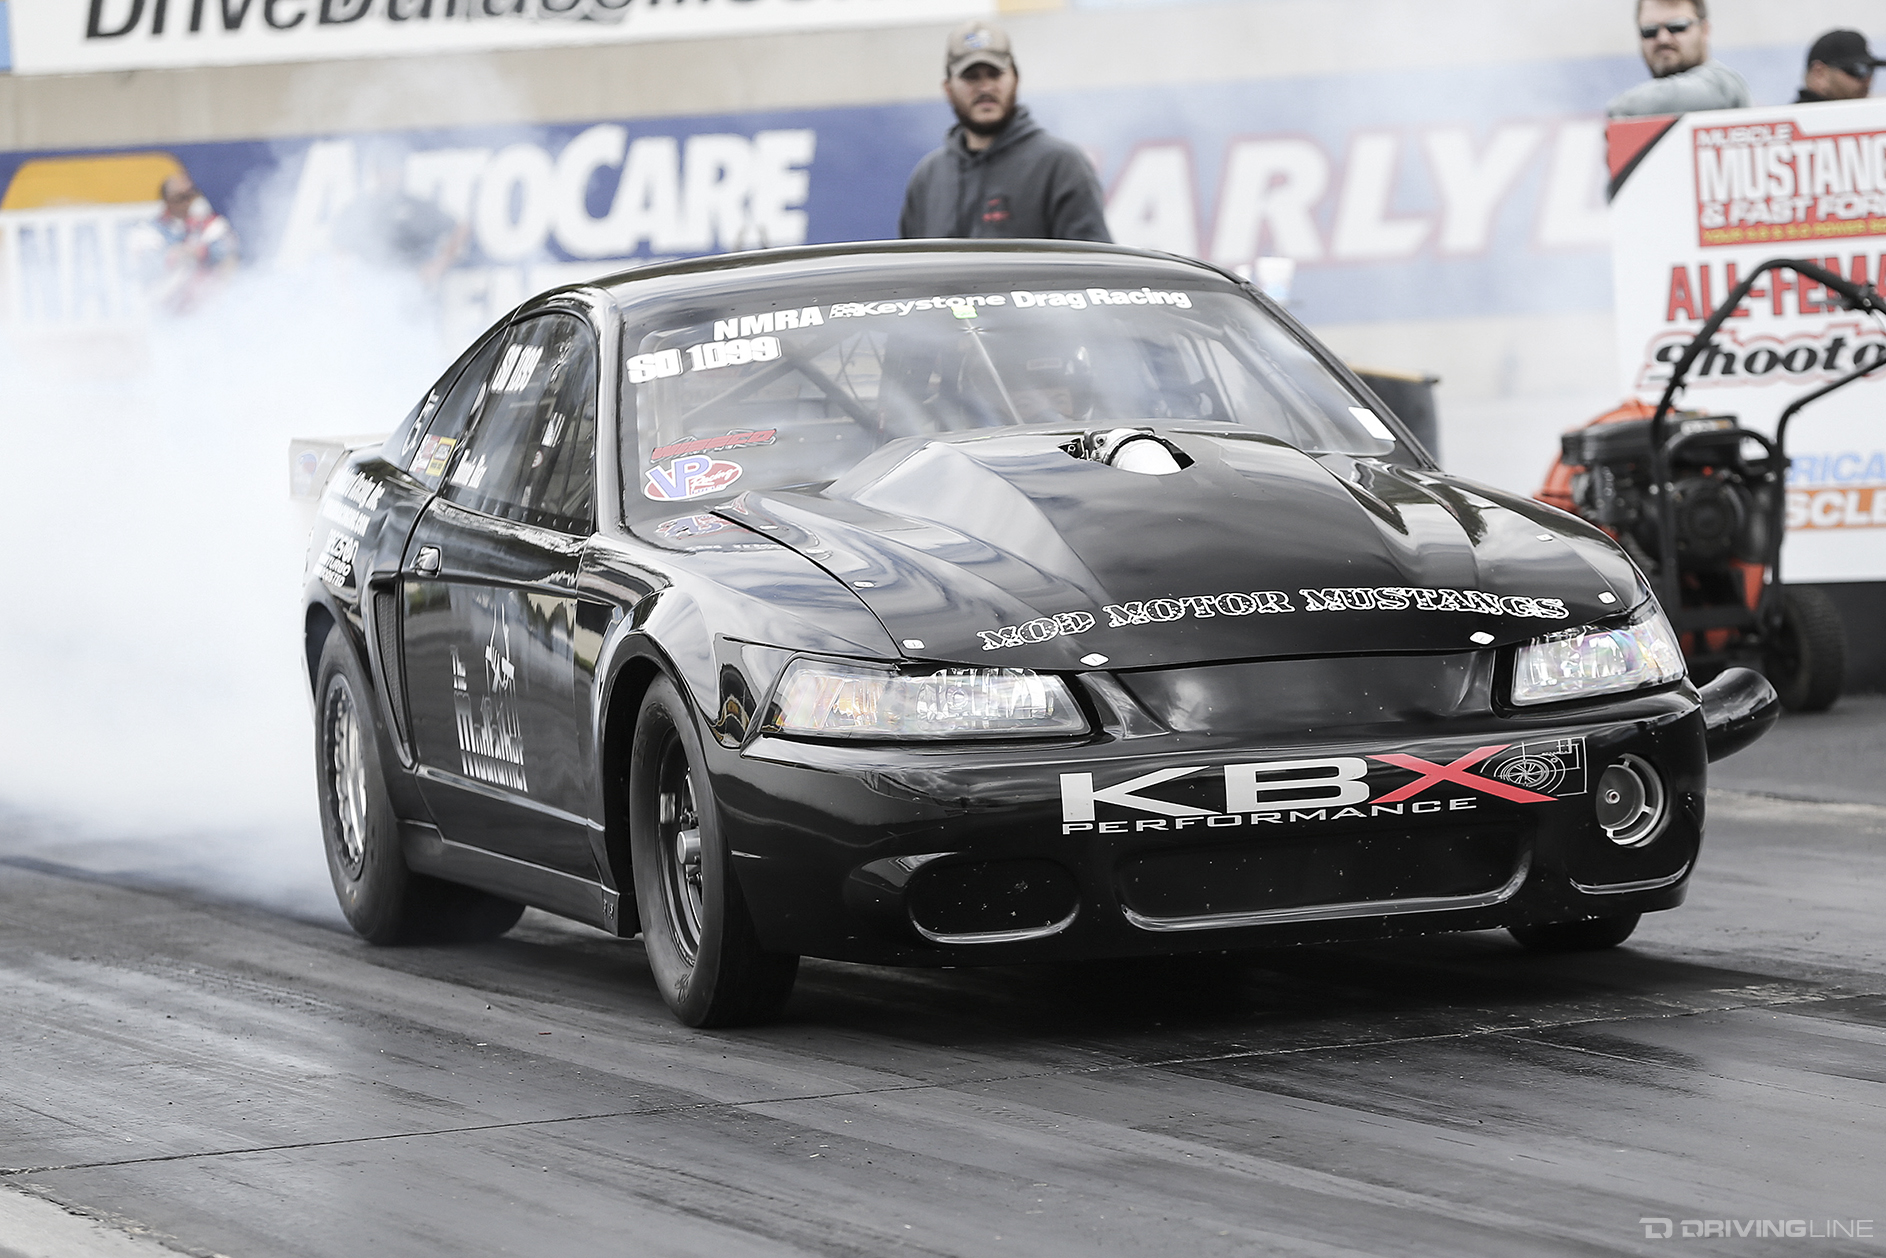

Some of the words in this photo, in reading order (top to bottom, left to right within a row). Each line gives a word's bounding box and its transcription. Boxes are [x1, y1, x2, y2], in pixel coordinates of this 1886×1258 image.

[274, 124, 816, 270] ATOCARE
[1728, 197, 1813, 227] FAST
[713, 305, 824, 341] NMRA
[857, 293, 1006, 317] Keystone
[1010, 290, 1087, 310] Drag
[1086, 287, 1193, 309] Racing
[649, 457, 710, 498] VP
[977, 610, 1096, 651] MOD
[1102, 591, 1296, 628] MOTOR
[1299, 587, 1570, 619] MUSTANGS
[1060, 744, 1558, 821] KBX
[1062, 797, 1477, 835] PERFORMANCE
